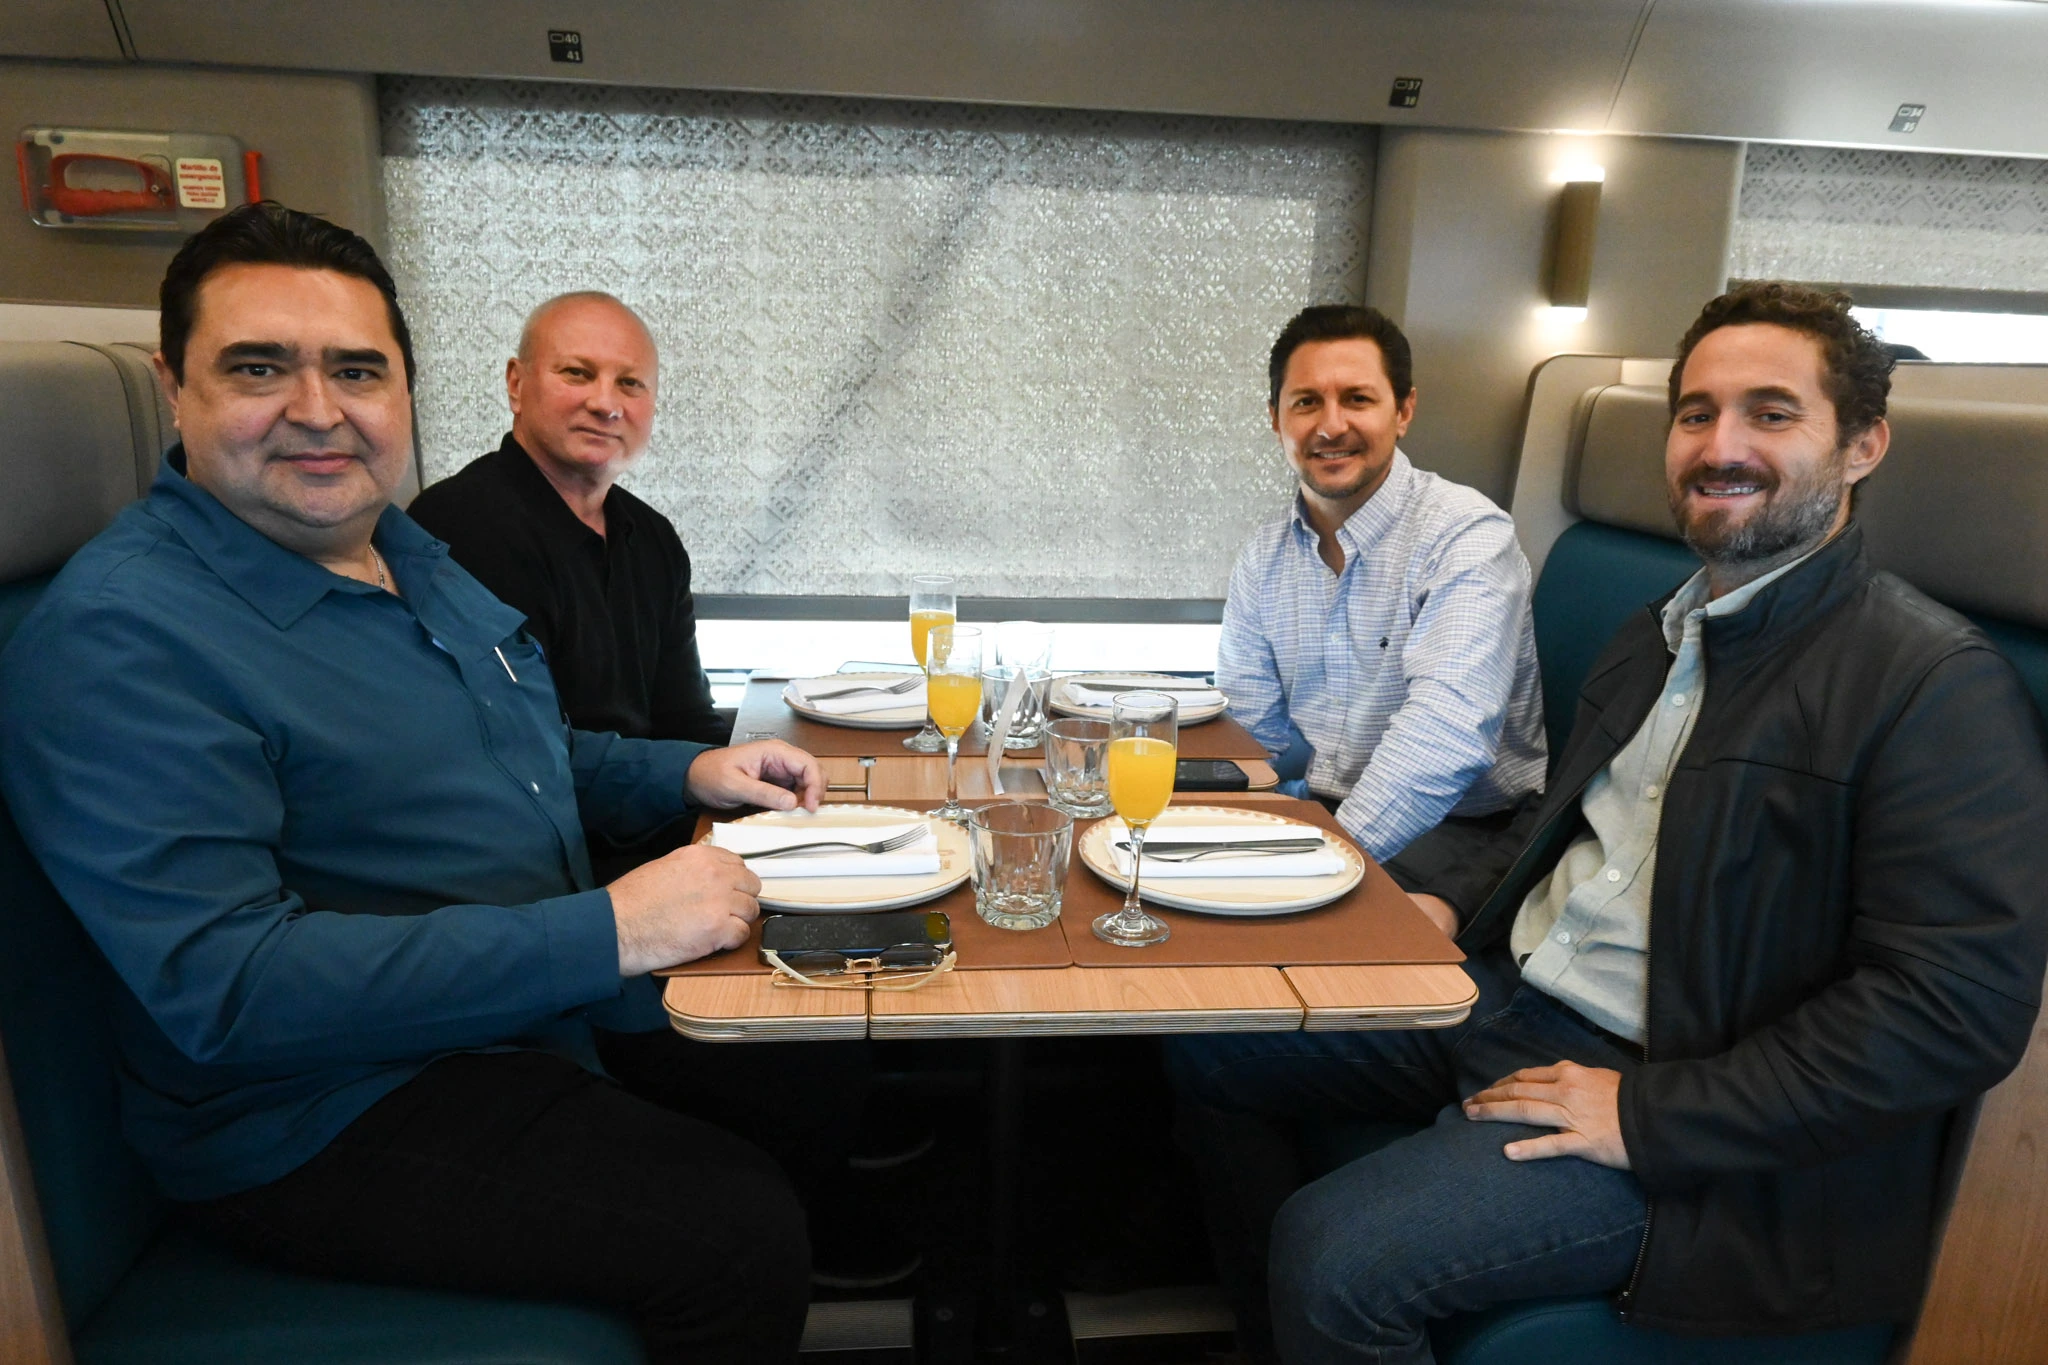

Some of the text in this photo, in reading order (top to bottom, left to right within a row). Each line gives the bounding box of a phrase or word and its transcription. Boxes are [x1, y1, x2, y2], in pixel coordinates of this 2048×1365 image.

[565, 34, 579, 45] 40
[568, 50, 581, 61] 41
[1408, 80, 1421, 90] 37
